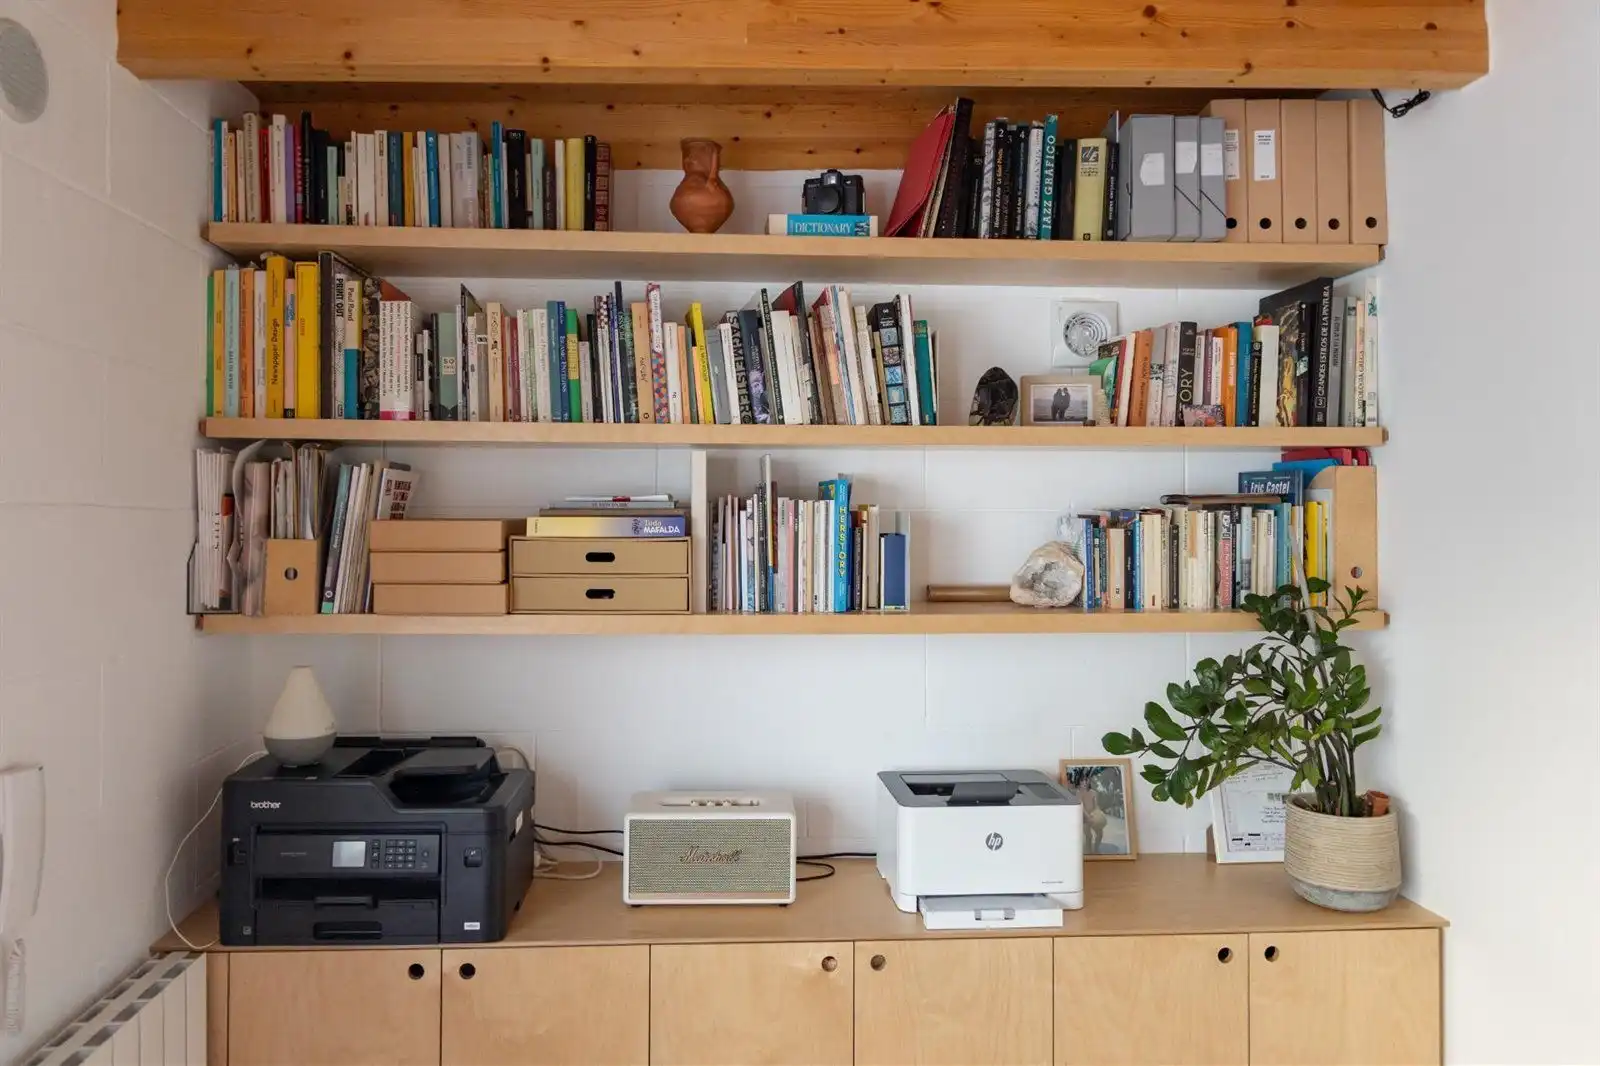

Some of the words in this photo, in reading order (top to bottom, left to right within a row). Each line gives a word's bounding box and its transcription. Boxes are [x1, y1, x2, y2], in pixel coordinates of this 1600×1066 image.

[1042, 200, 1052, 230] JAZZ
[795, 222, 852, 233] DICTIONARY
[336, 278, 344, 300] PRINT
[347, 288, 355, 301] Paul
[336, 302, 344, 317] OUT
[347, 302, 355, 321] Rand
[271, 318, 280, 342] Design
[1318, 363, 1326, 396] GRANDES
[1322, 285, 1330, 316] PINTURA
[271, 344, 280, 385] Newspaper
[728, 314, 752, 414] SAGMEISTER
[1250, 482, 1265, 494] Eric
[1266, 481, 1290, 494] Castel
[643, 525, 681, 534] MAFALDA
[250, 801, 281, 810] brother
[987, 832, 1002, 850] hp
